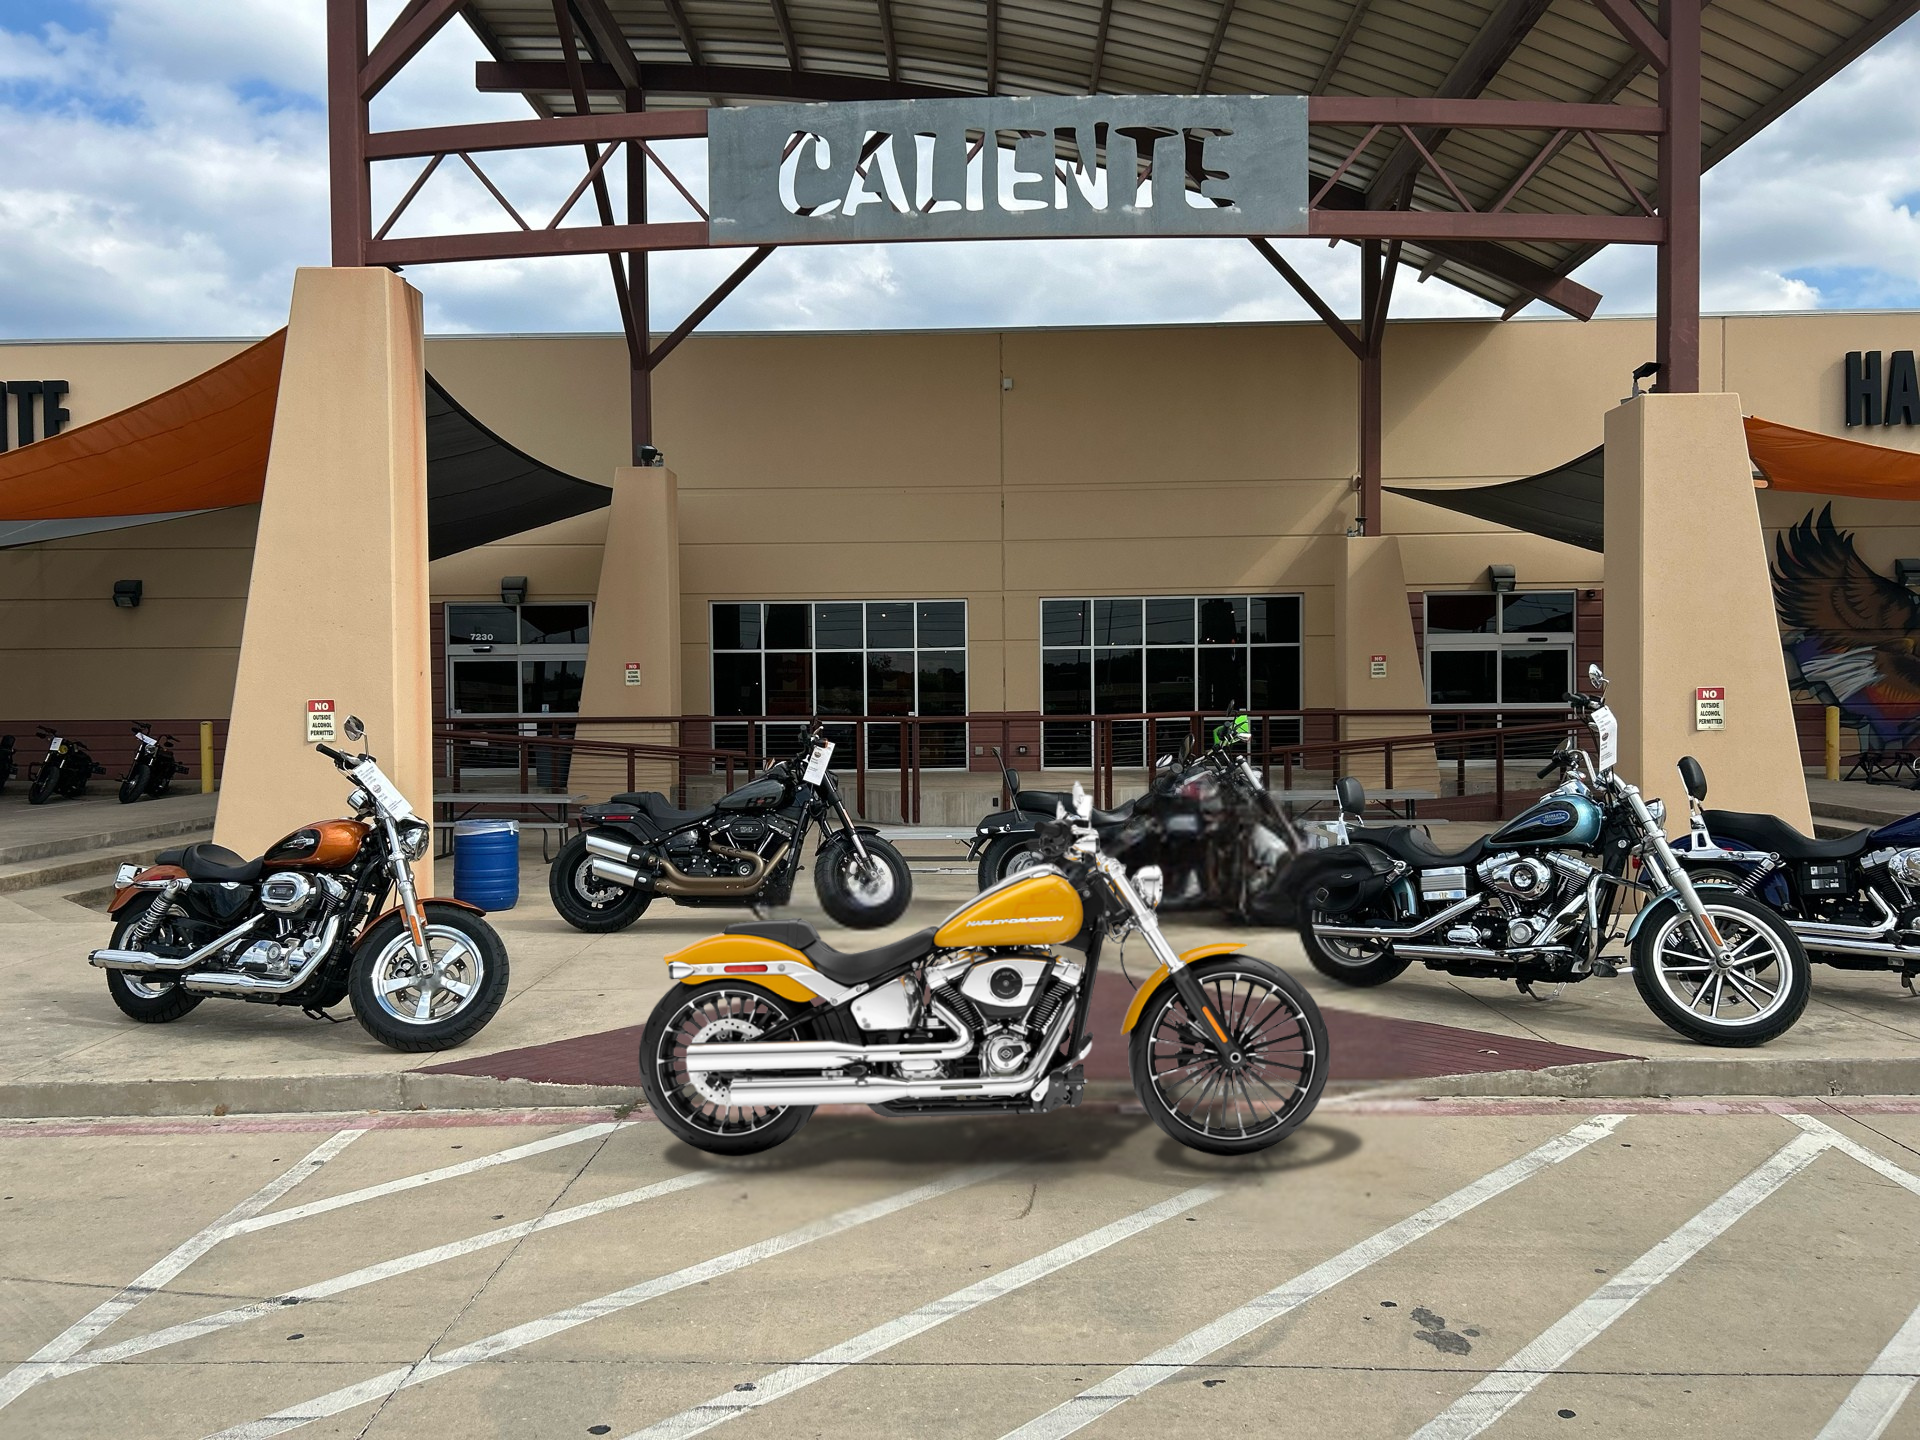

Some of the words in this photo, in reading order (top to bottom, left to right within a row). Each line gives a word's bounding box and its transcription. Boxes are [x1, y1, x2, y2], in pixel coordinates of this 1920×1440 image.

[778, 122, 1237, 217] CALIENTE
[470, 633, 494, 641] 7230
[1702, 690, 1718, 699] NO
[314, 702, 329, 711] NO
